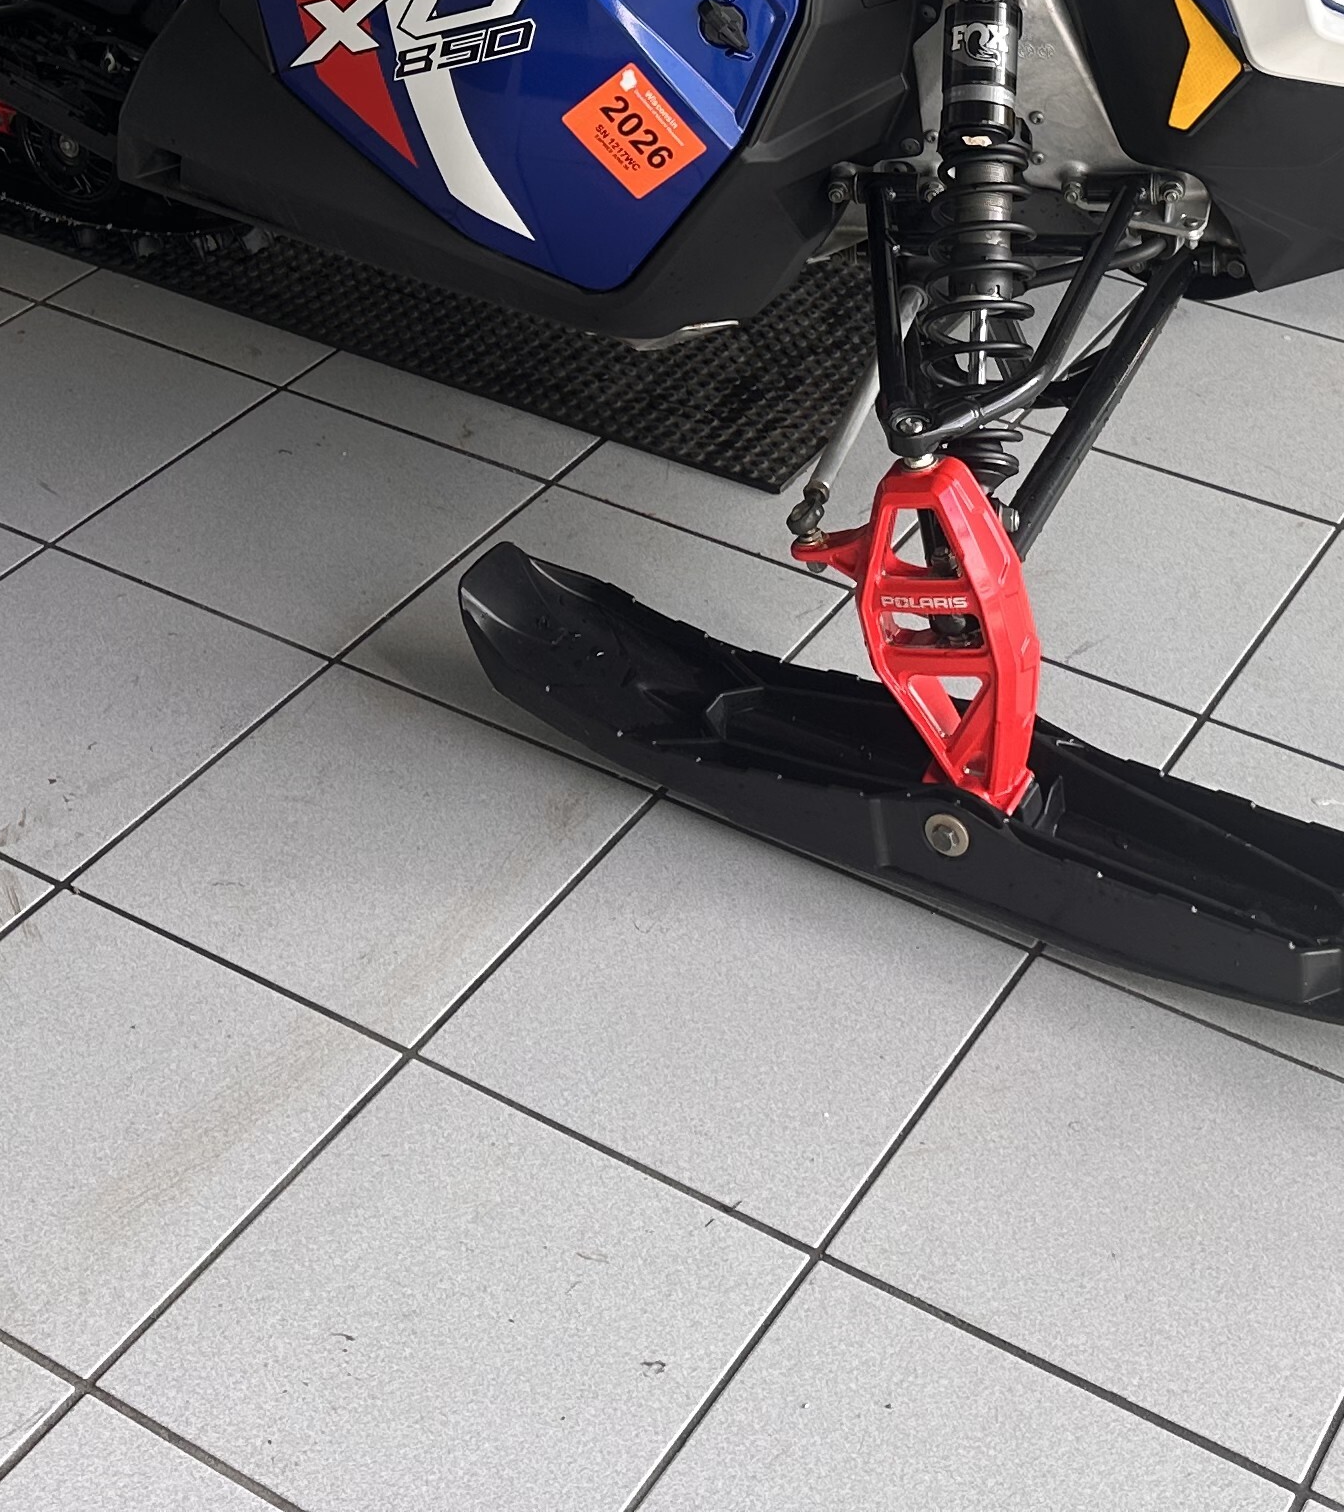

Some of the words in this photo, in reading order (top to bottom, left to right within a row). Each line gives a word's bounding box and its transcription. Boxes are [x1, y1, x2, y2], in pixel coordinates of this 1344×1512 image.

[393, 18, 536, 81] 850
[951, 23, 1009, 65] FOX
[644, 89, 678, 129] Wisconsin
[595, 124, 609, 138] SN
[599, 95, 674, 169] 2026
[881, 595, 968, 609] POLARIS
